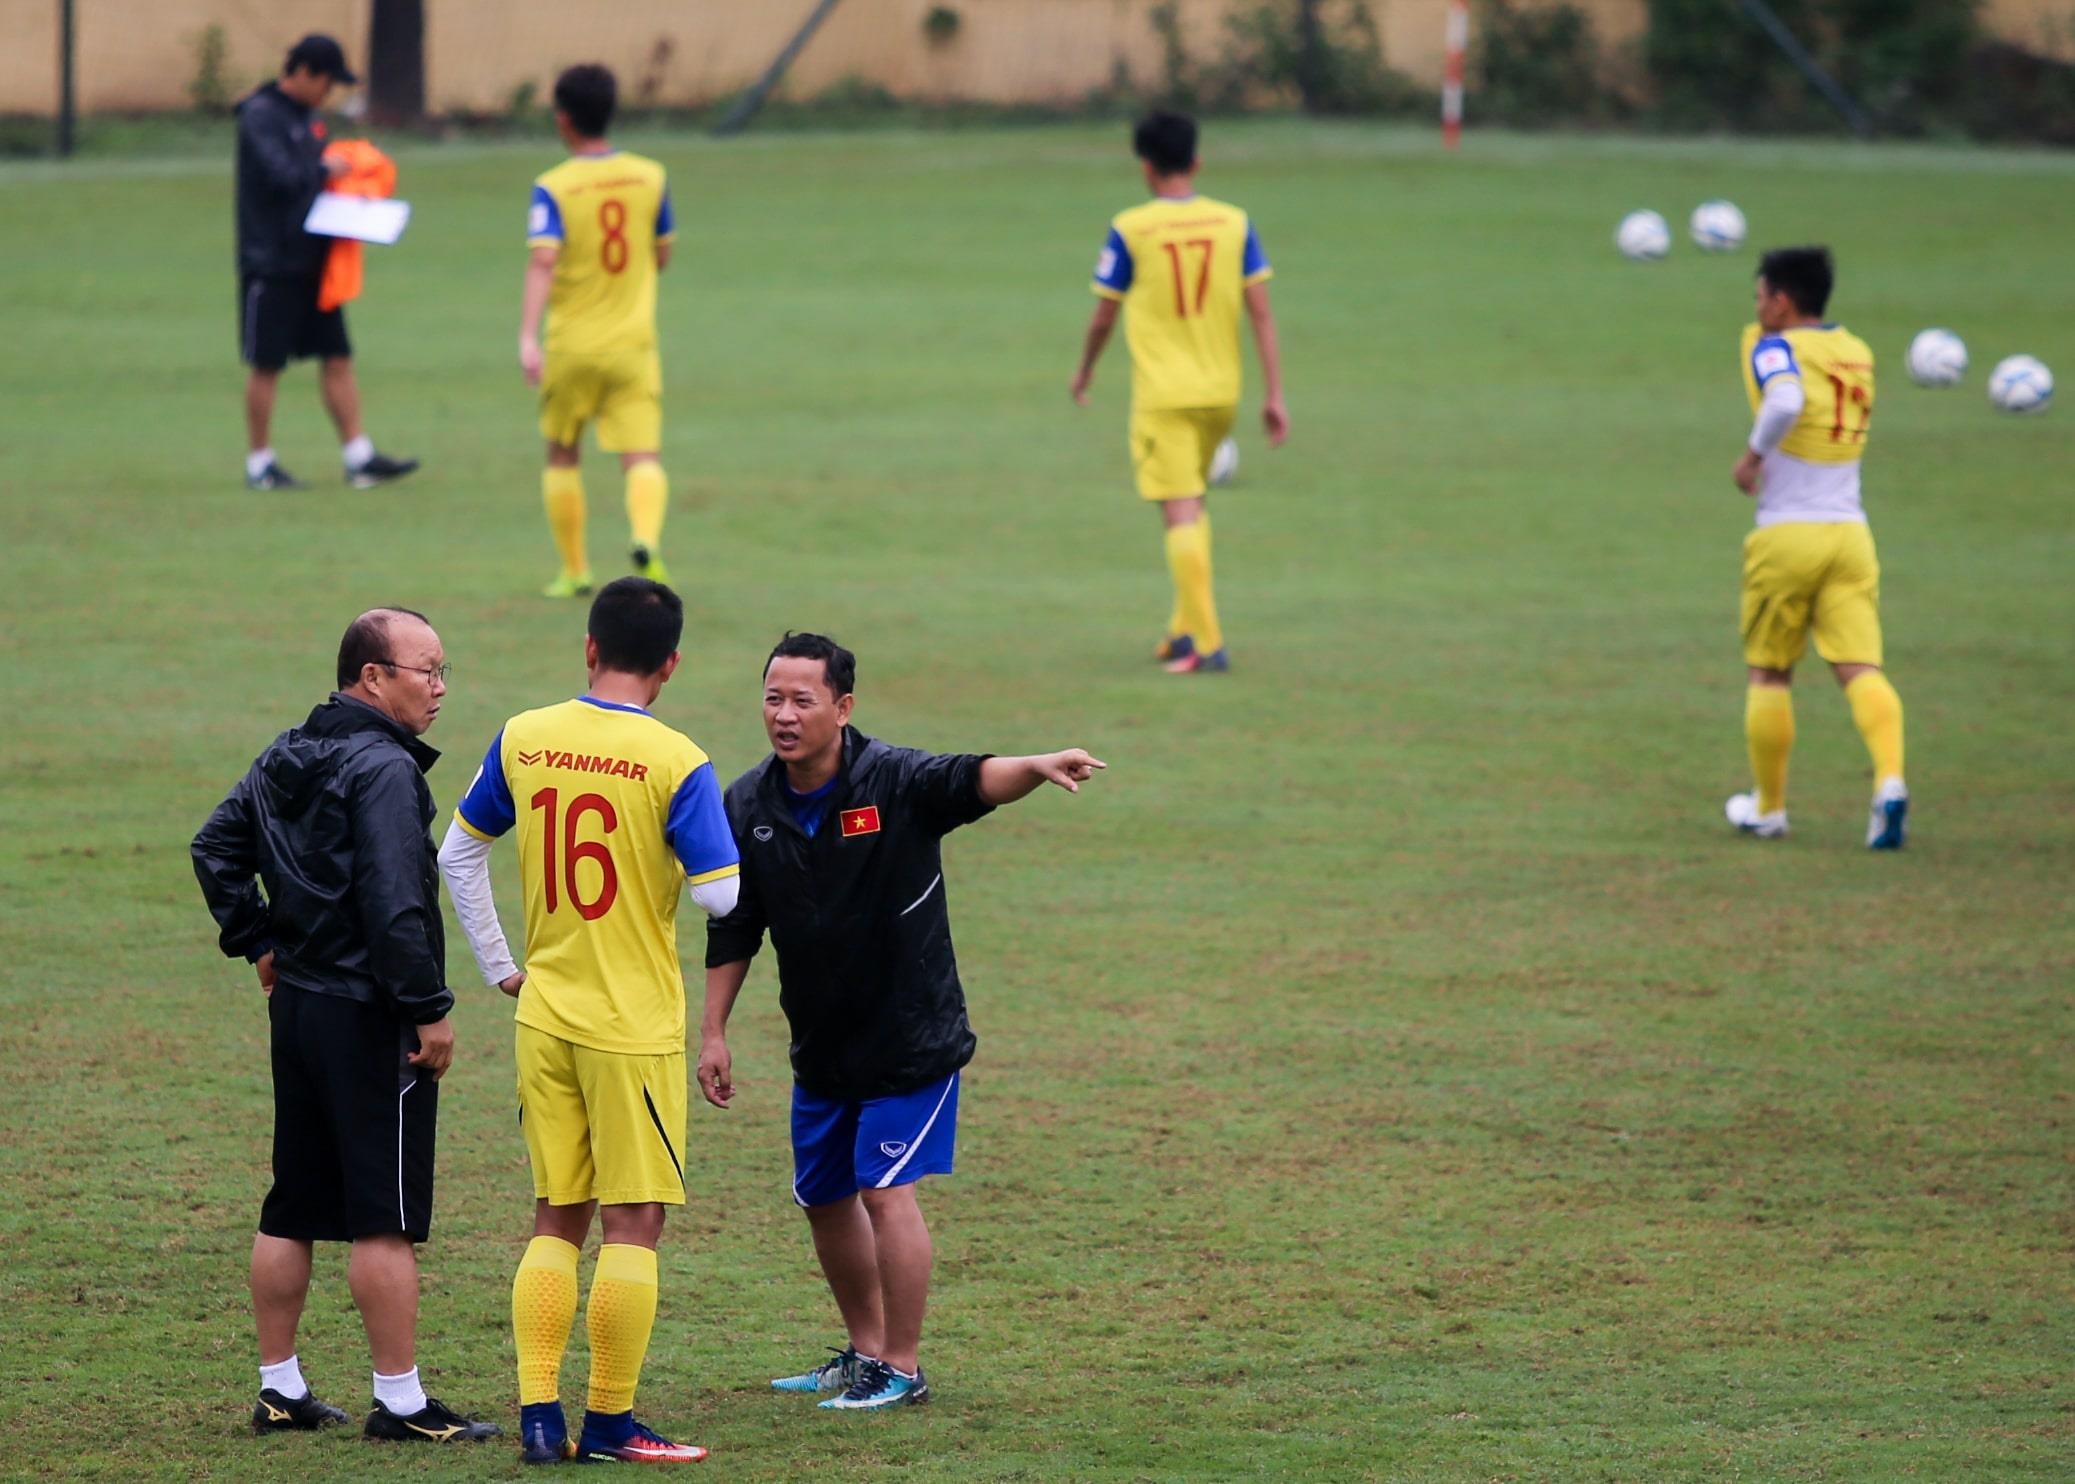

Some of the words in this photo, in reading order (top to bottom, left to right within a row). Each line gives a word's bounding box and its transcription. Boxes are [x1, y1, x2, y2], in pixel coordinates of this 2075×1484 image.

[599, 198, 628, 275] 8
[1162, 237, 1213, 319] 17
[544, 749, 648, 782] YANMAR
[531, 787, 618, 921] 16
